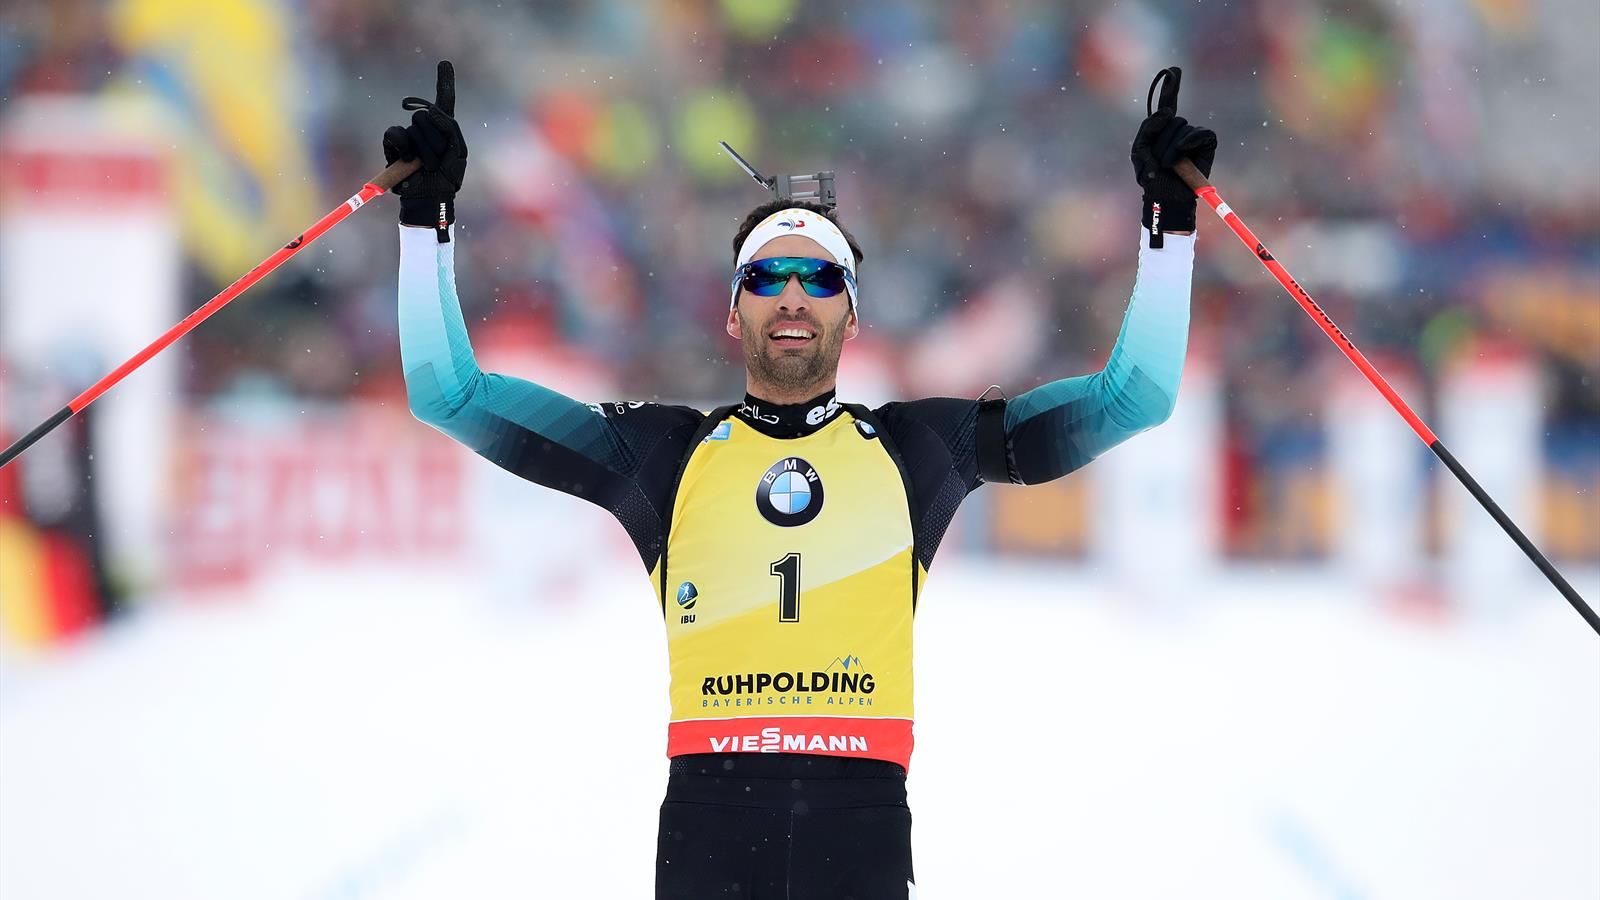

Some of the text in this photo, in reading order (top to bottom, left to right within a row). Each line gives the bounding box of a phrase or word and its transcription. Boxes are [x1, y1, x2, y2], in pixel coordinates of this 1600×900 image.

[764, 459, 817, 483] BMW
[769, 553, 801, 623] 1
[680, 614, 696, 624] IBU
[701, 672, 875, 696] RUHPOLDING
[702, 696, 873, 708] BAYERISCHE ALPEN
